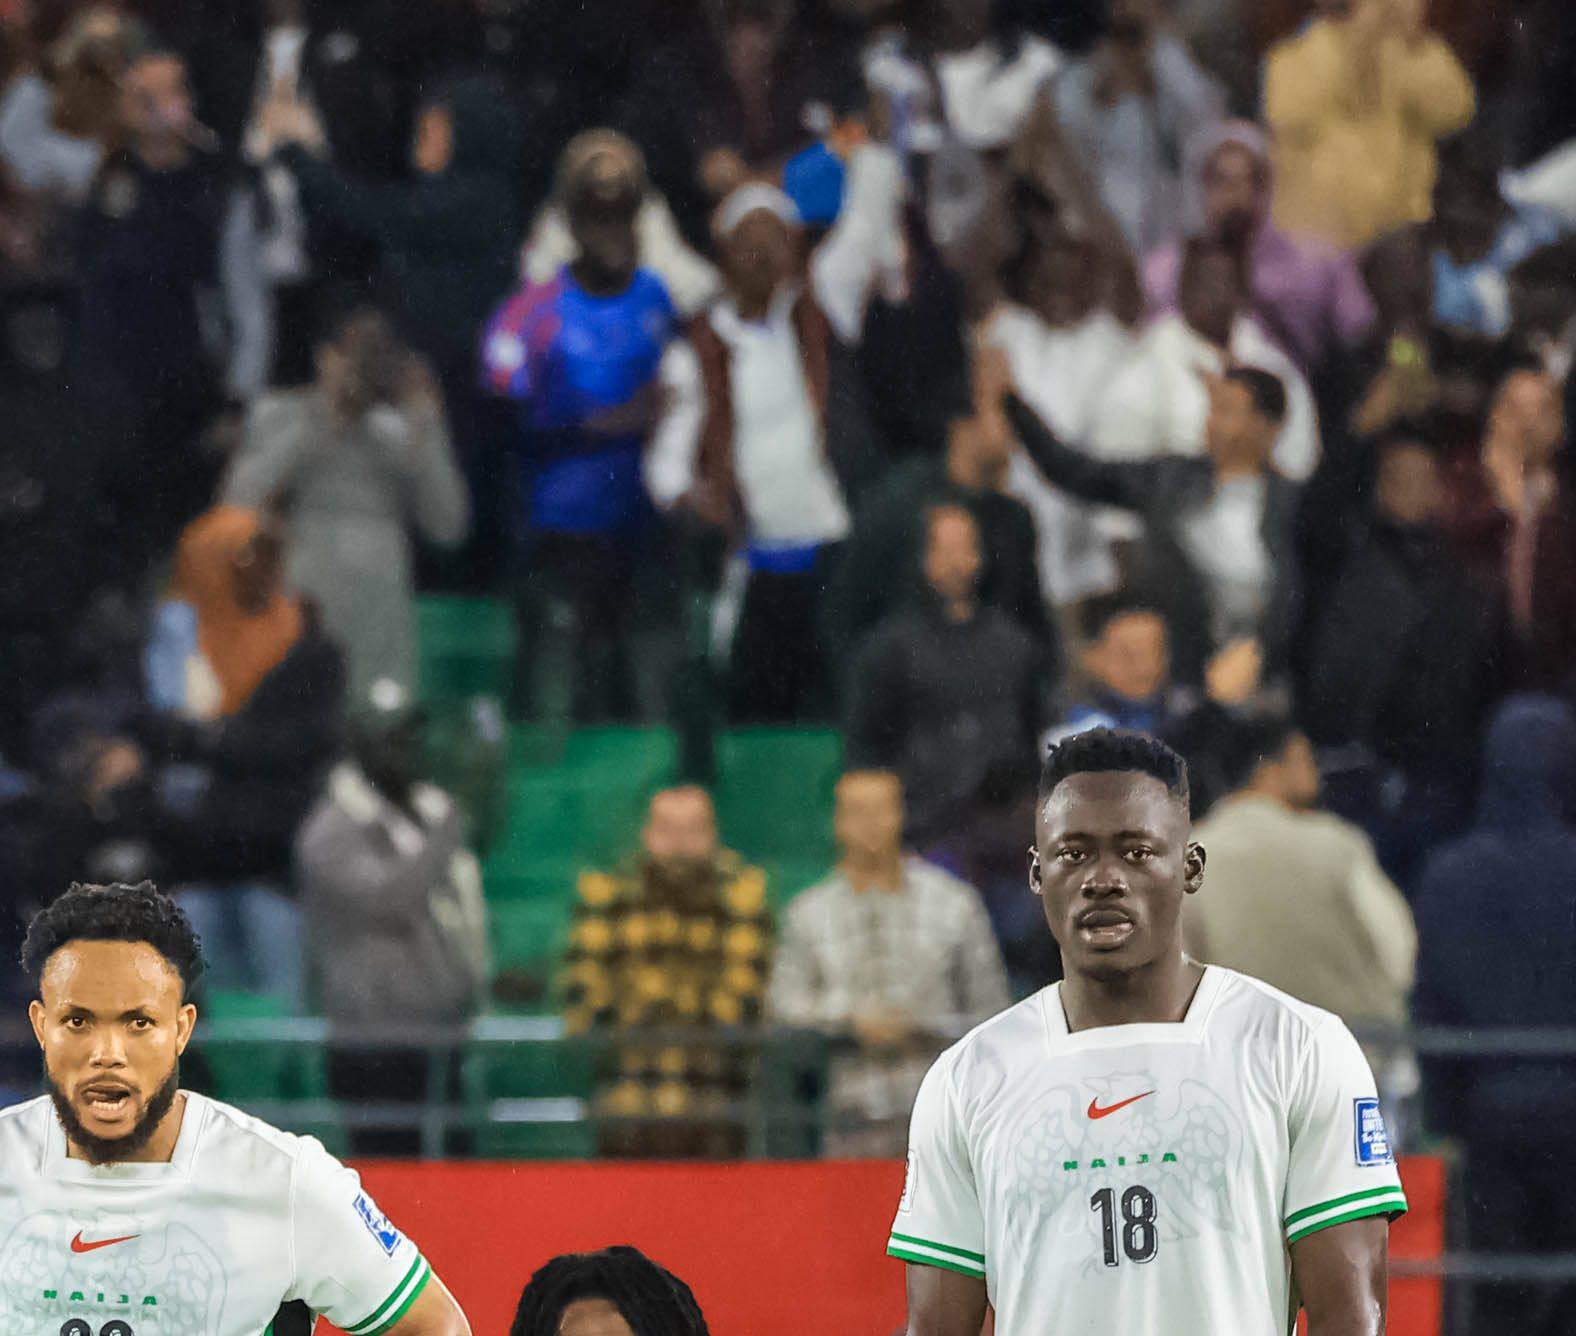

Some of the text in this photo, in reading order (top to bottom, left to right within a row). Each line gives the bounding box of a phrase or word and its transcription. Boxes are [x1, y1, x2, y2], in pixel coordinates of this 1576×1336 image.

[1064, 1153, 1177, 1170] NAIJA
[1090, 1185, 1158, 1267] 18
[44, 1289, 157, 1306] NAIJA
